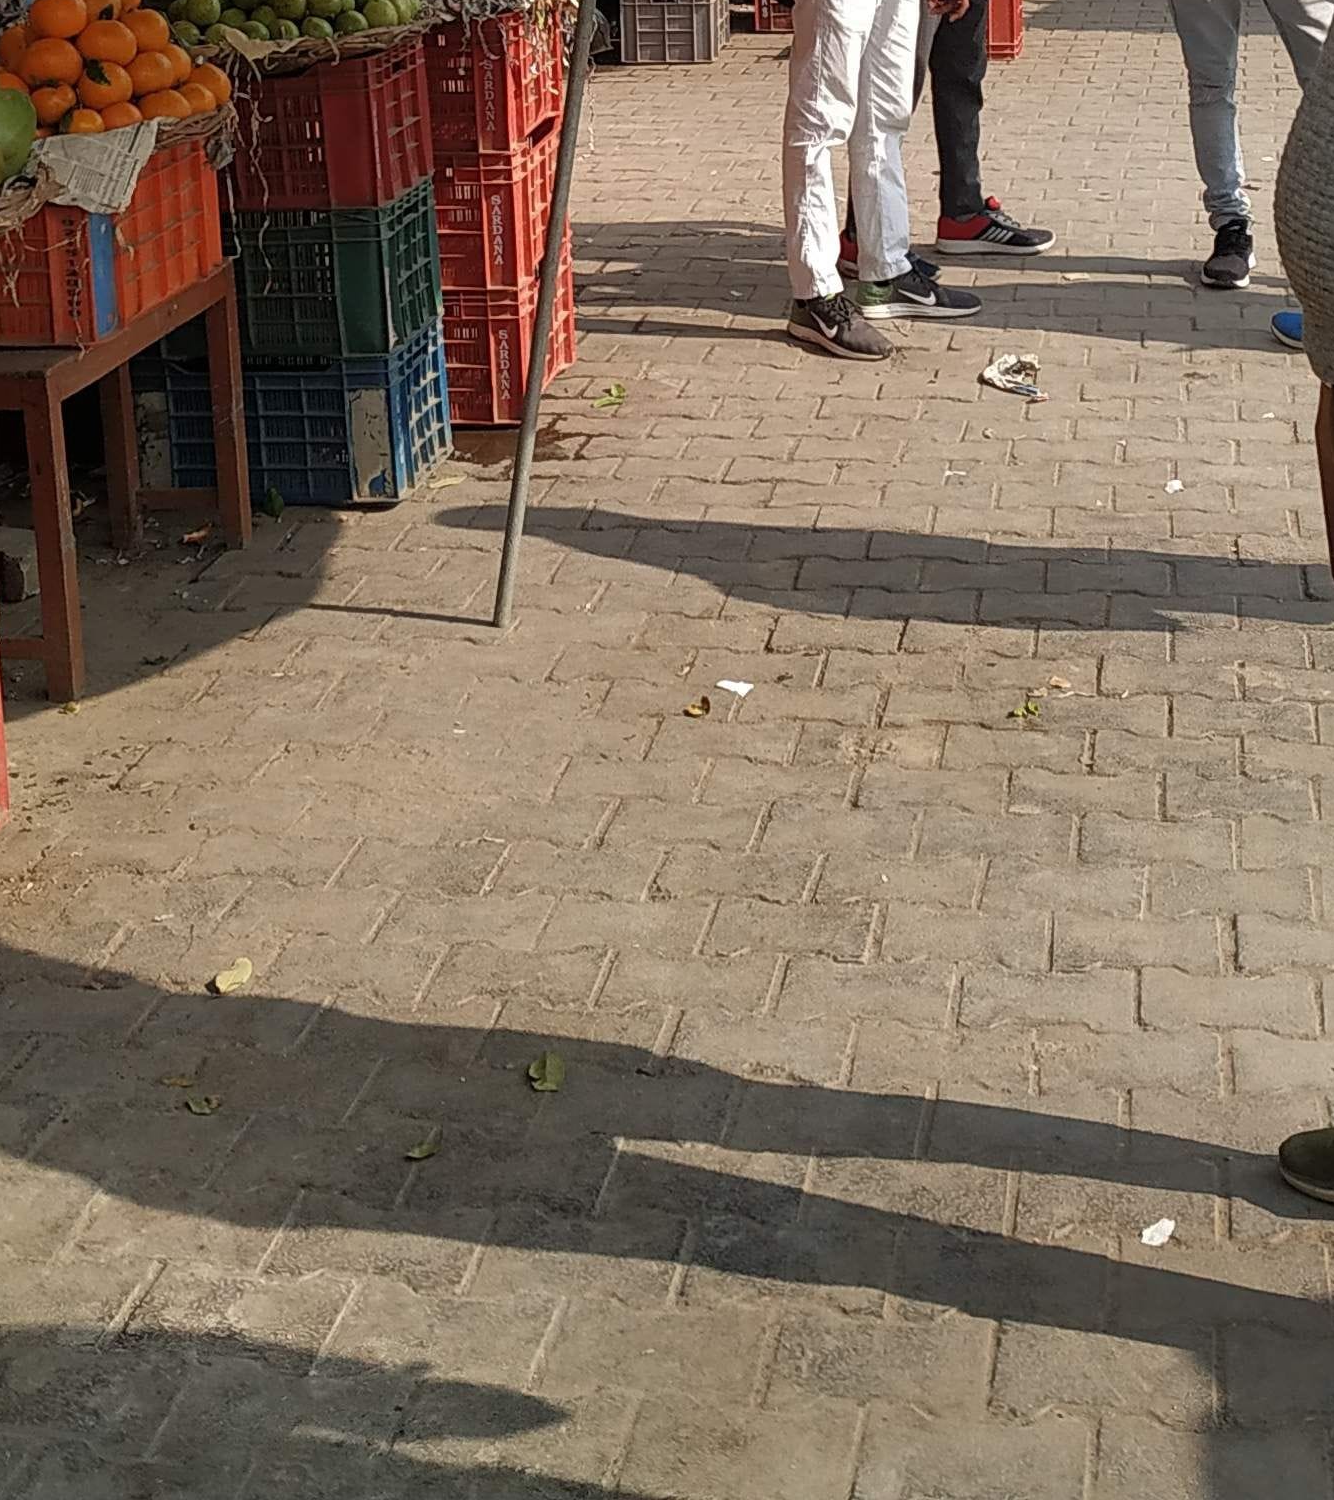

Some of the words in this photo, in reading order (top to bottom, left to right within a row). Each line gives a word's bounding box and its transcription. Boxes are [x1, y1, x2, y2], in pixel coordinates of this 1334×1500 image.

[481, 59, 497, 131] SARDANA
[491, 195, 505, 265] SARDANA
[498, 329, 512, 400] SARDANA
